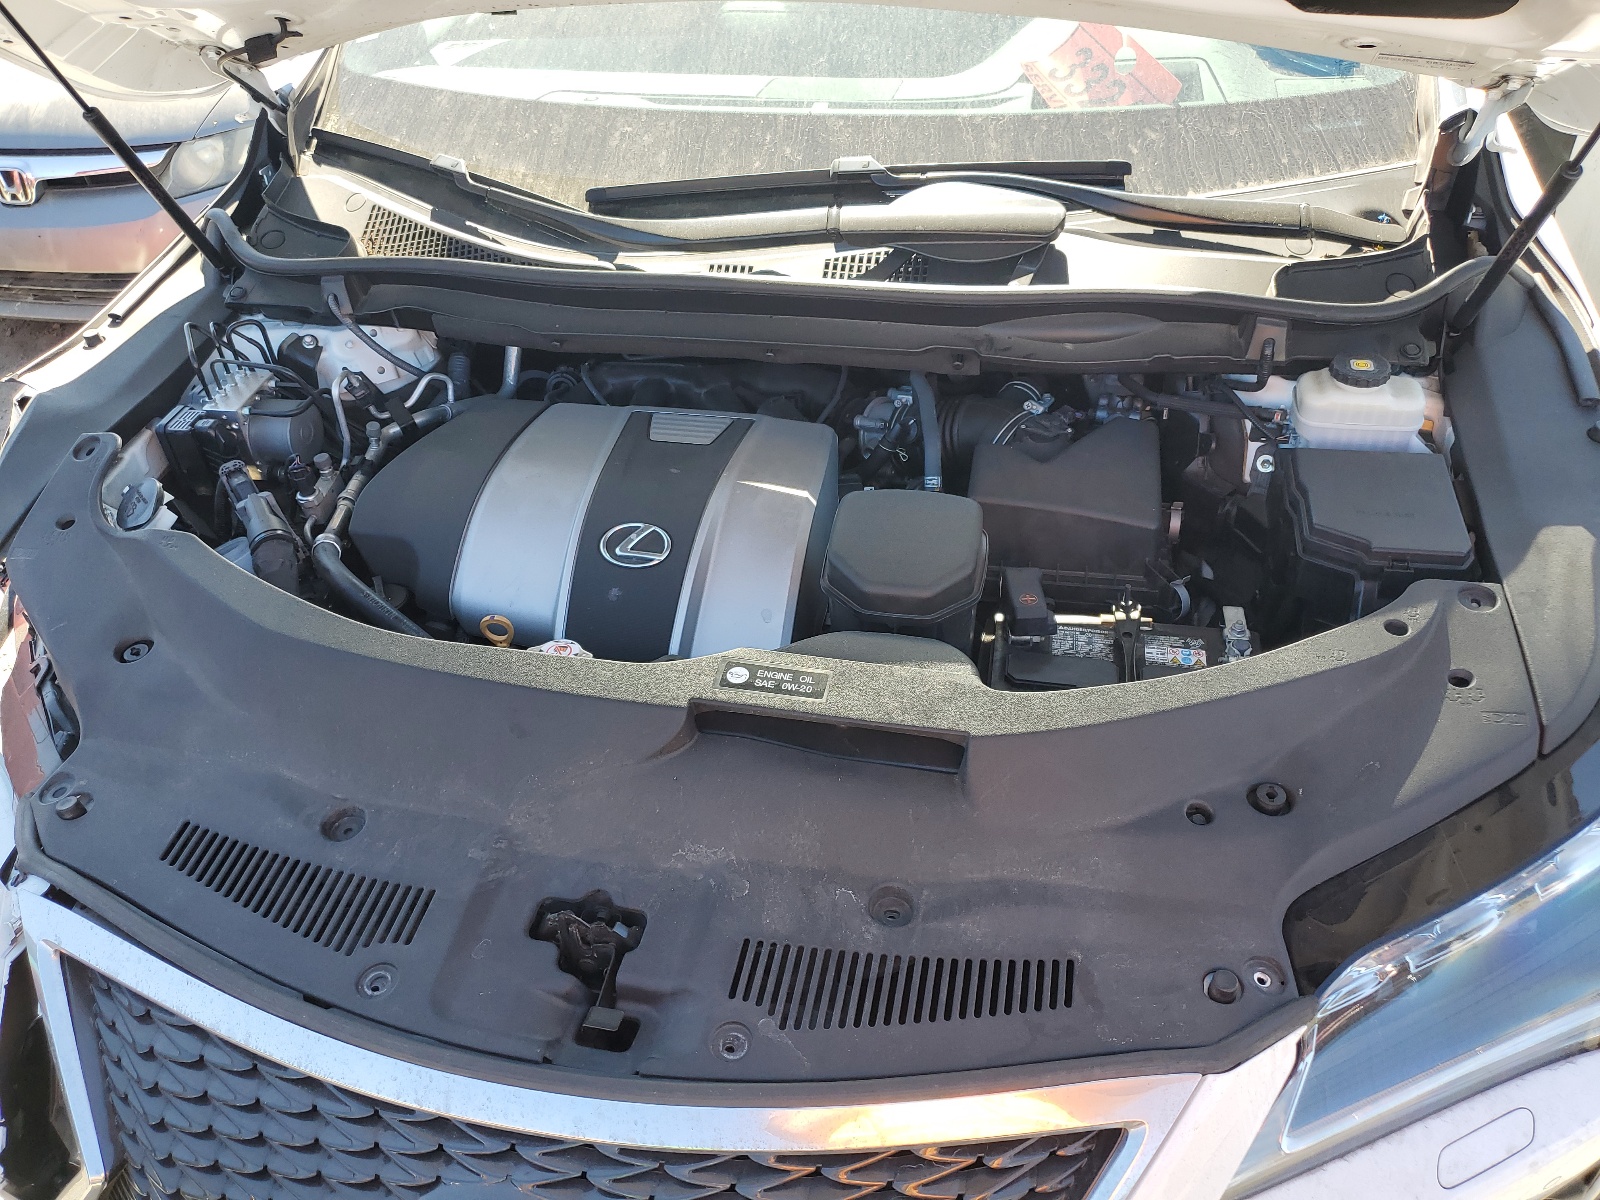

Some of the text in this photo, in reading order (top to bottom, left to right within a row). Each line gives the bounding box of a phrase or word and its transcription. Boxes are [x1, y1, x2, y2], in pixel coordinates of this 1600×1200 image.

[756, 669, 816, 684] ENGINE OIL
[754, 679, 813, 693] SAE 0W-20
